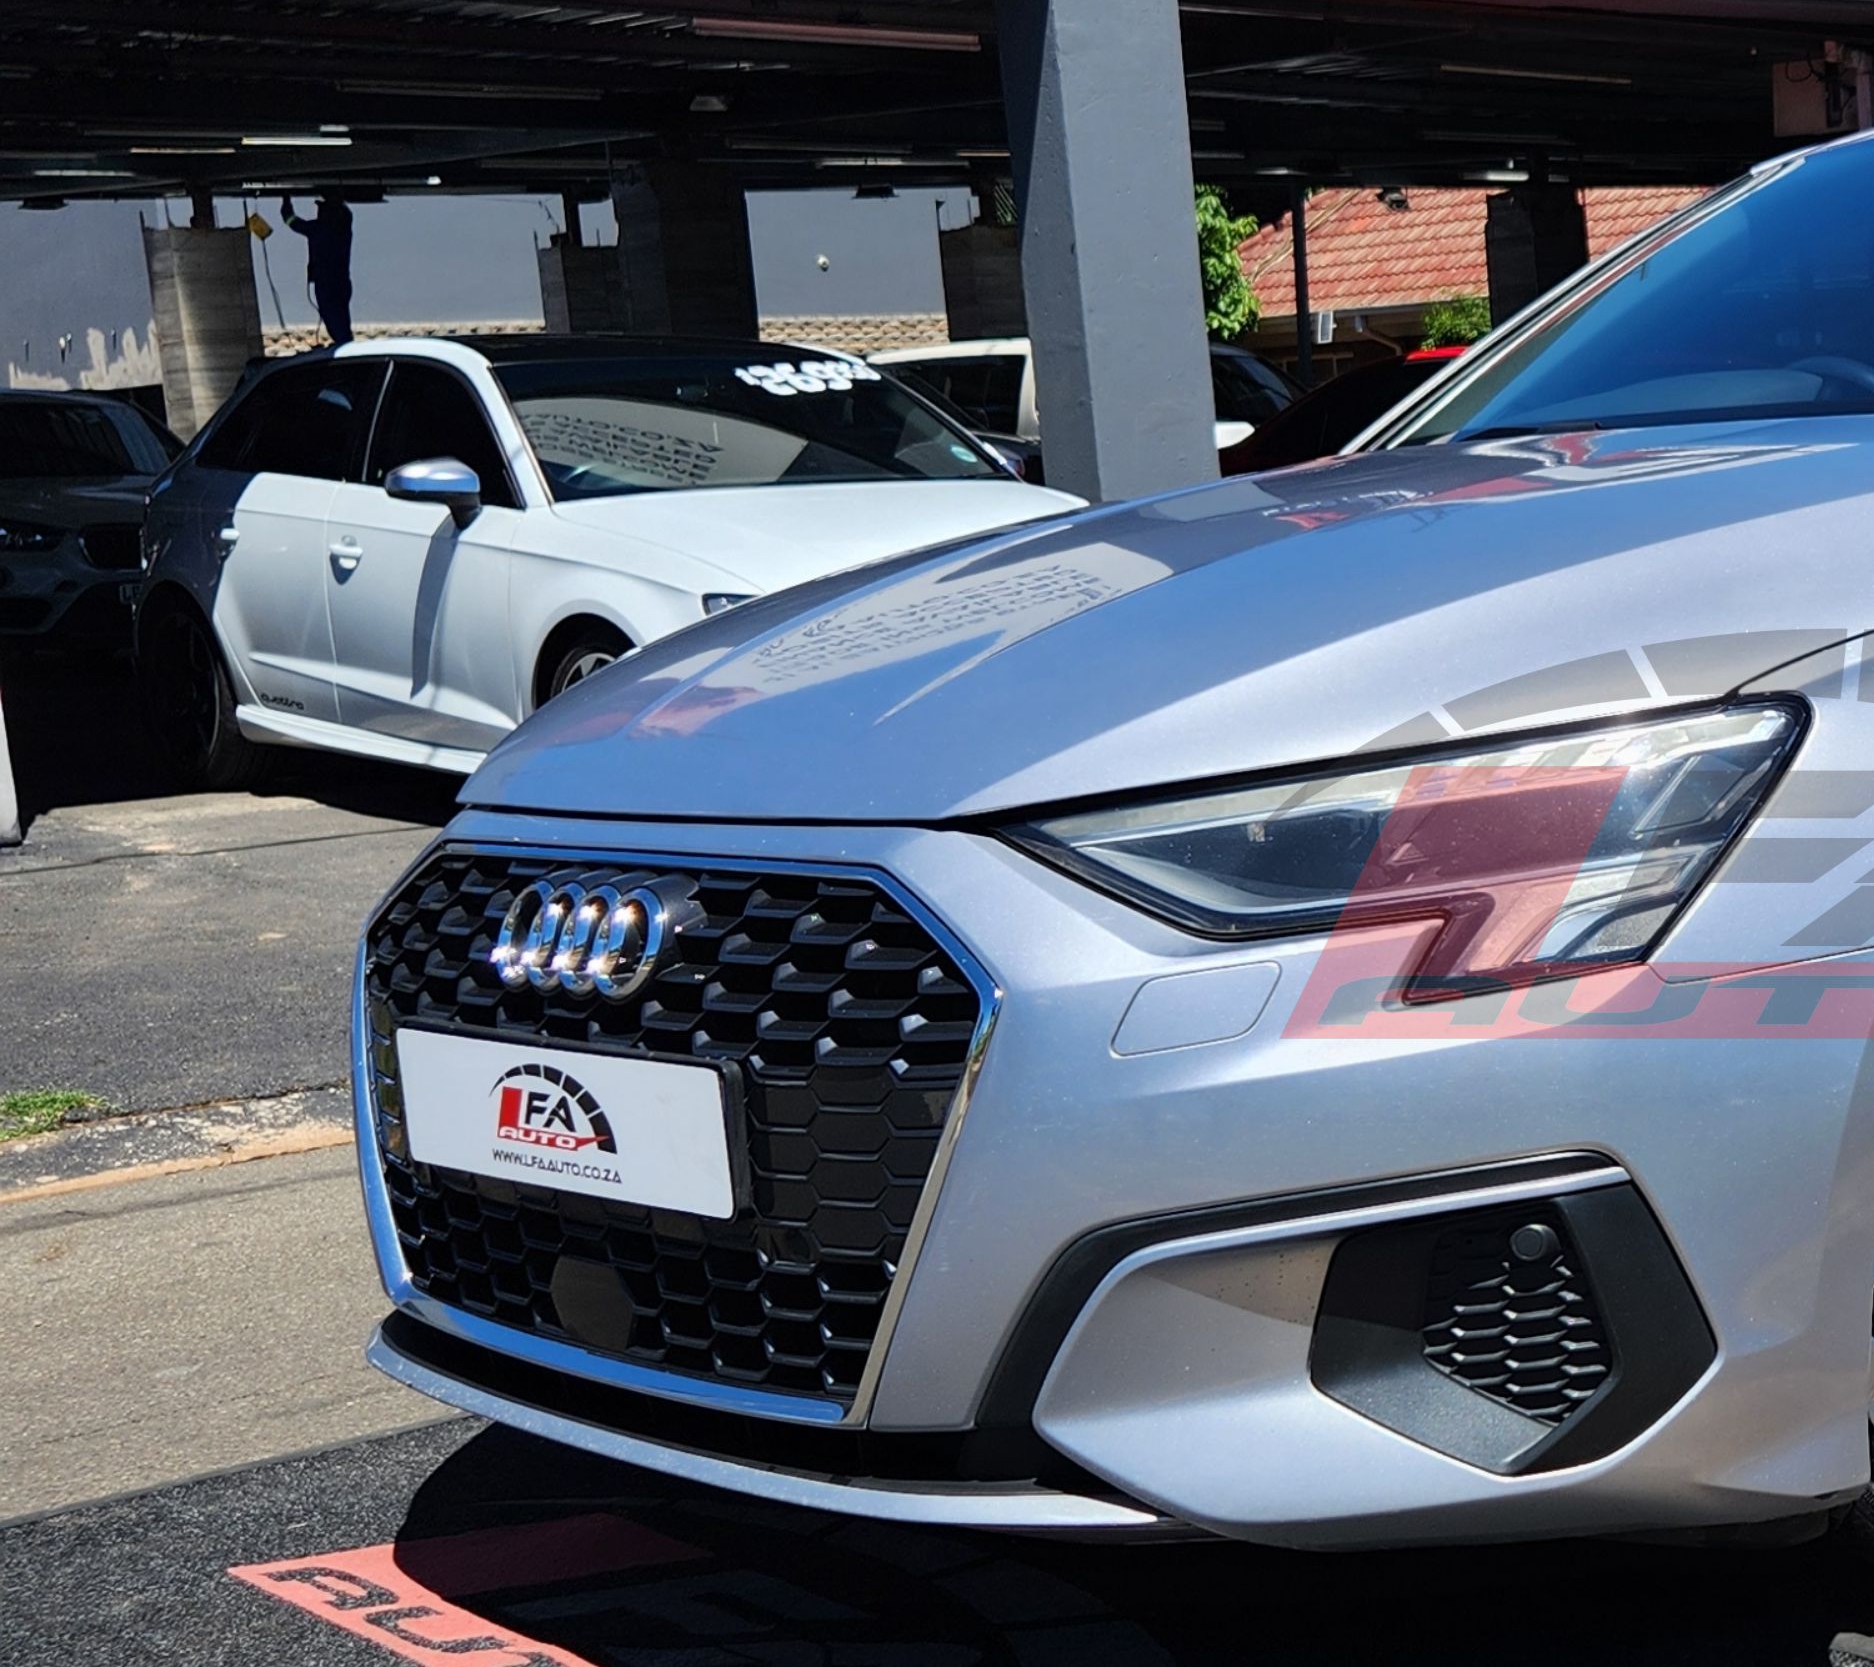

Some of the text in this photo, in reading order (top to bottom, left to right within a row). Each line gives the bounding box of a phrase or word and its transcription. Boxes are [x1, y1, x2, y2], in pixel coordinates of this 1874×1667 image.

[499, 1086, 577, 1132] LFA
[499, 1126, 577, 1149] AUTO
[492, 1148, 623, 1184] WWW.LFAAUTO.CO.ZA
